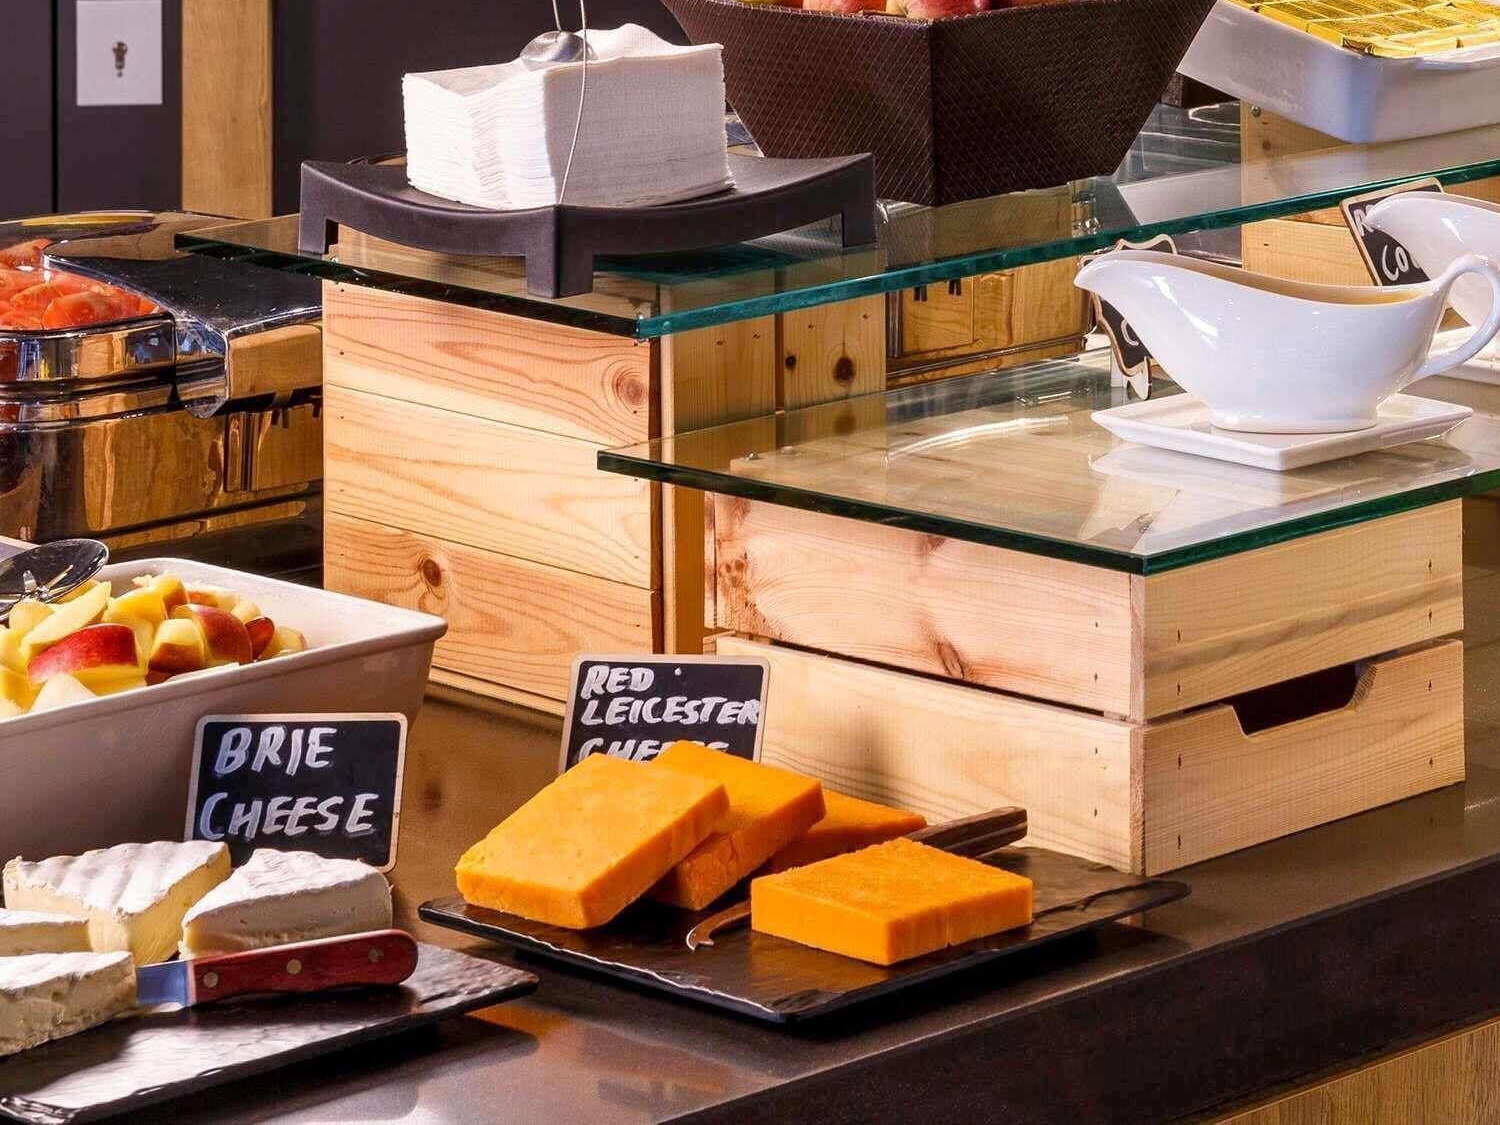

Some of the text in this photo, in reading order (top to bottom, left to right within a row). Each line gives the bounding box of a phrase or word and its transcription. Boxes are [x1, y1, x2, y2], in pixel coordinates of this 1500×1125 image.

[580, 665, 654, 699] RED
[580, 696, 760, 726] LEICESTER
[214, 726, 338, 775] BRIE
[578, 738, 730, 763] CHE
[199, 792, 380, 841] CHEESE
